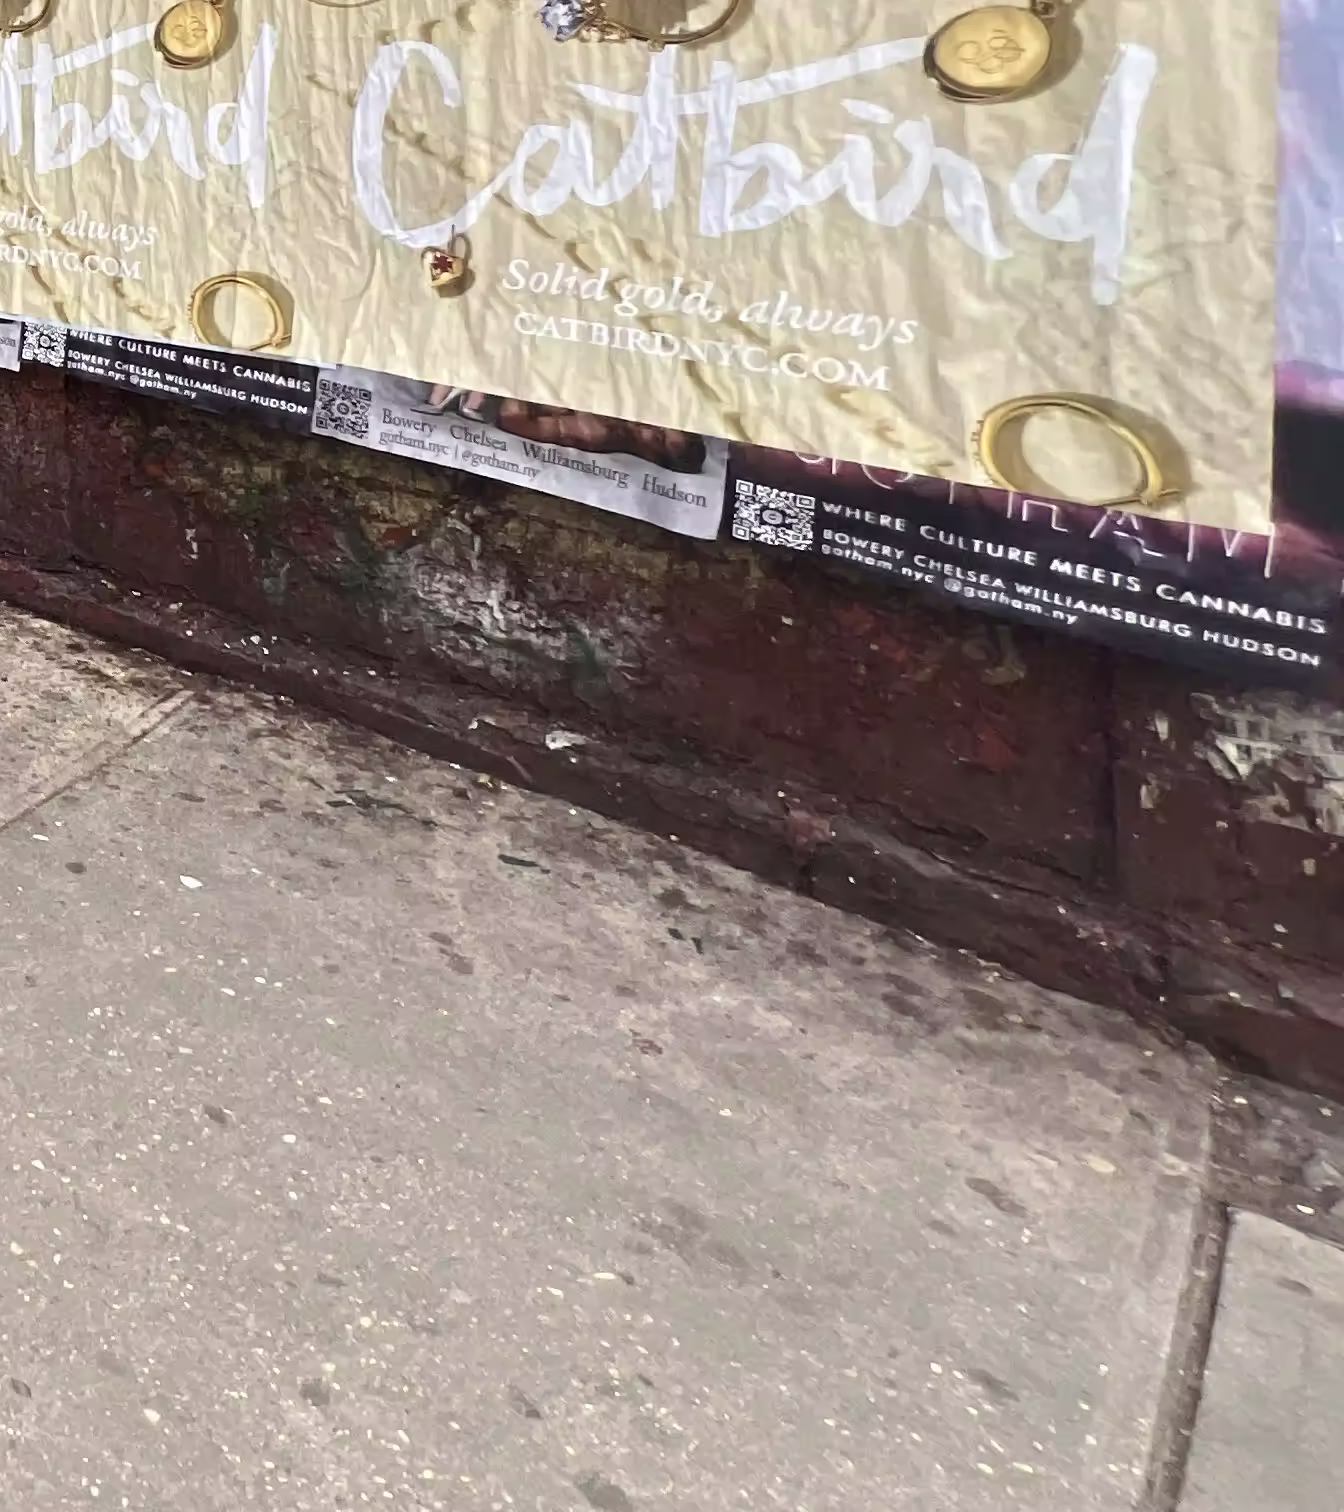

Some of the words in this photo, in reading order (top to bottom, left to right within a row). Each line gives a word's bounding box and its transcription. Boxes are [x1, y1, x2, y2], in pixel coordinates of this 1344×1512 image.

[351, 36, 1159, 306] Catbird
[61, 210, 160, 251] always
[502, 258, 611, 303] Solid
[613, 275, 723, 324] gold,
[738, 289, 920, 351] always
[67, 349, 111, 367] BOWERY
[114, 360, 161, 380] CHELSEA
[164, 371, 247, 402] WILLIAMSBURG
[250, 394, 309, 416] HUDSON
[118, 339, 178, 363] CULTURE
[182, 353, 227, 374] MEETS
[232, 364, 312, 393] CANNABIS
[513, 311, 891, 391] CATBIRDNYC.COM
[378, 430, 450, 457] gotham.nyc
[461, 449, 541, 482] @gotham.ny
[381, 407, 436, 437] Bowery
[449, 423, 509, 453] Chelsea
[520, 440, 629, 490] Williamsburg
[641, 473, 708, 509] Hudson
[821, 499, 910, 533] WHERE
[919, 524, 1039, 568] CULTURE
[1049, 558, 1142, 593] MEETS
[1155, 583, 1328, 635] CANNABIS
[821, 542, 936, 585] gotham.nyc
[943, 577, 1079, 625] @gotham.ny
[822, 528, 905, 561] BOWERY
[912, 554, 1007, 590] CHELSEA
[1014, 581, 1194, 639] WILLIAMSBURG
[1202, 629, 1322, 668] HUDSON
